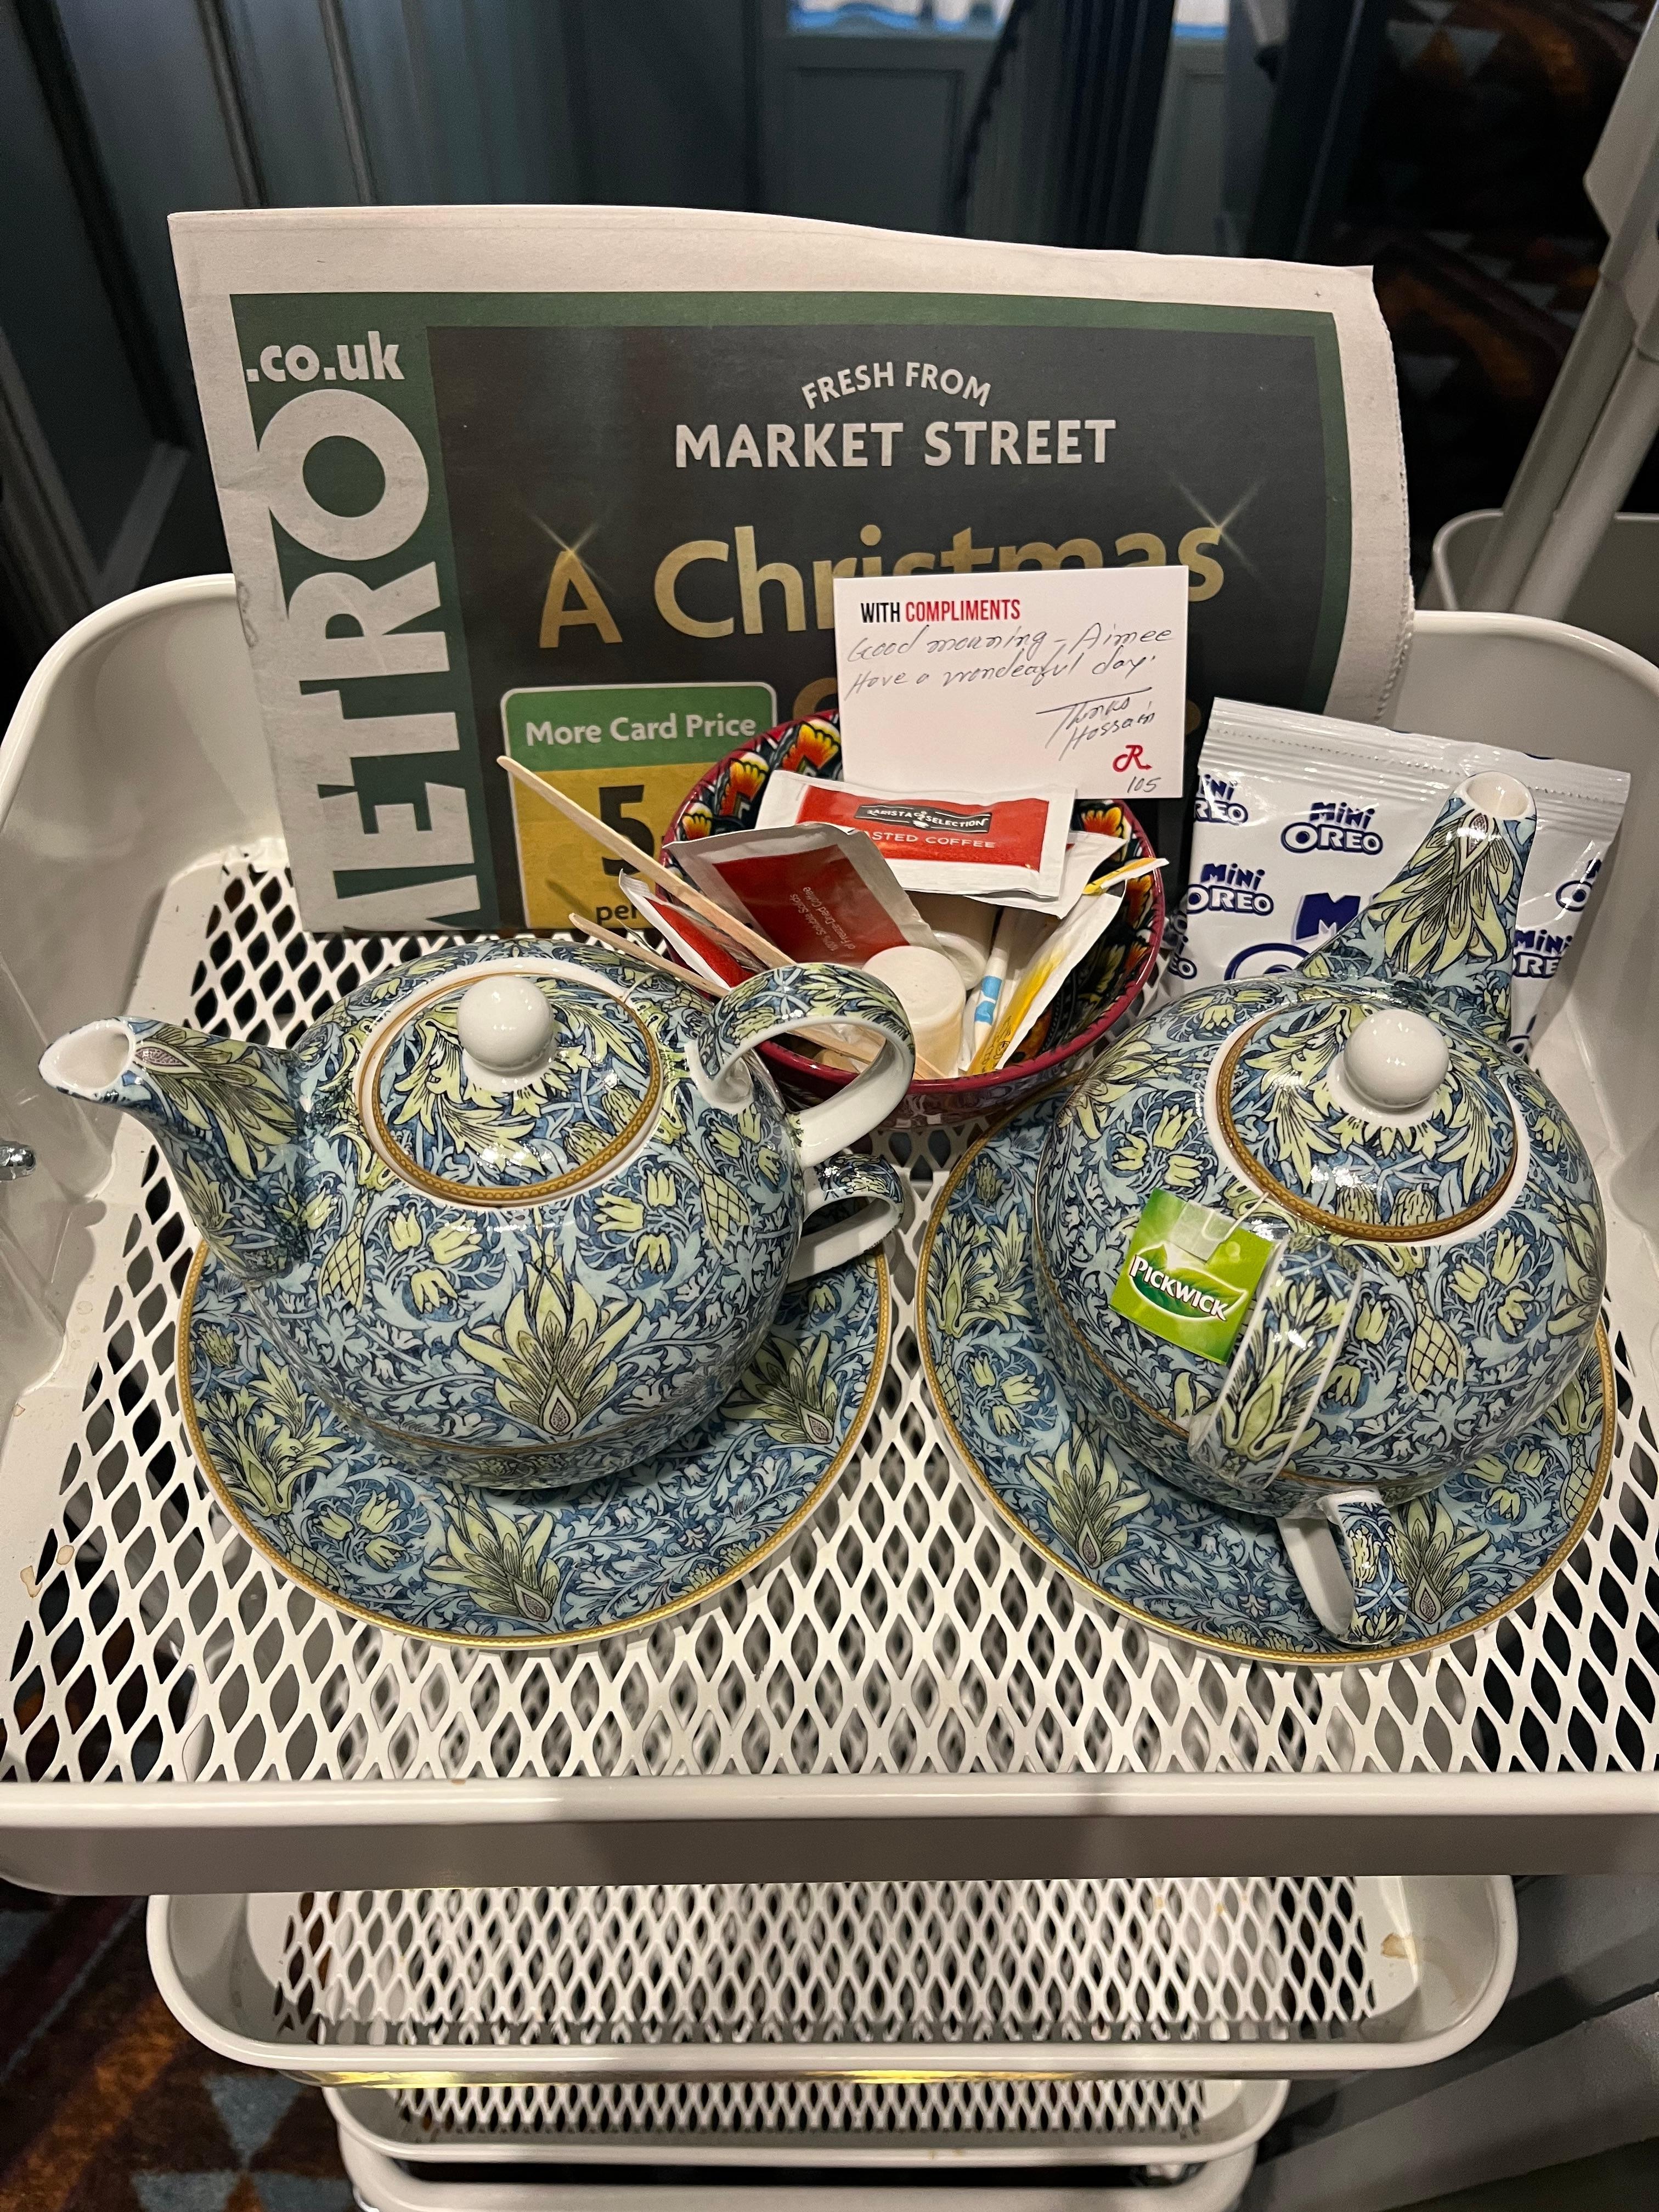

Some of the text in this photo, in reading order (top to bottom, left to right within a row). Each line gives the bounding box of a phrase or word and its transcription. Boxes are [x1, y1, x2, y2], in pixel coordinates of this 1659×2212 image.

[246, 330, 405, 382] .co.uk
[802, 362, 991, 410] FRESH FROM
[675, 420, 1116, 468] MARKET STREET
[539, 549, 623, 648] A
[860, 599, 1021, 623] WITH COMPLIMENTS
[847, 624, 930, 662] Good
[1067, 622, 1176, 654] Aimee
[843, 670, 908, 702] Have
[916, 673, 930, 685] a
[526, 713, 757, 746] More Card Price
[1127, 776, 1163, 794] 105
[925, 815, 990, 828] SELECTION
[1194, 798, 1248, 825] REO
[925, 836, 996, 849] COFFEE
[1280, 821, 1383, 855] OREO
[1186, 883, 1274, 916] OREO
[1128, 1254, 1229, 1322] PICKWICK
